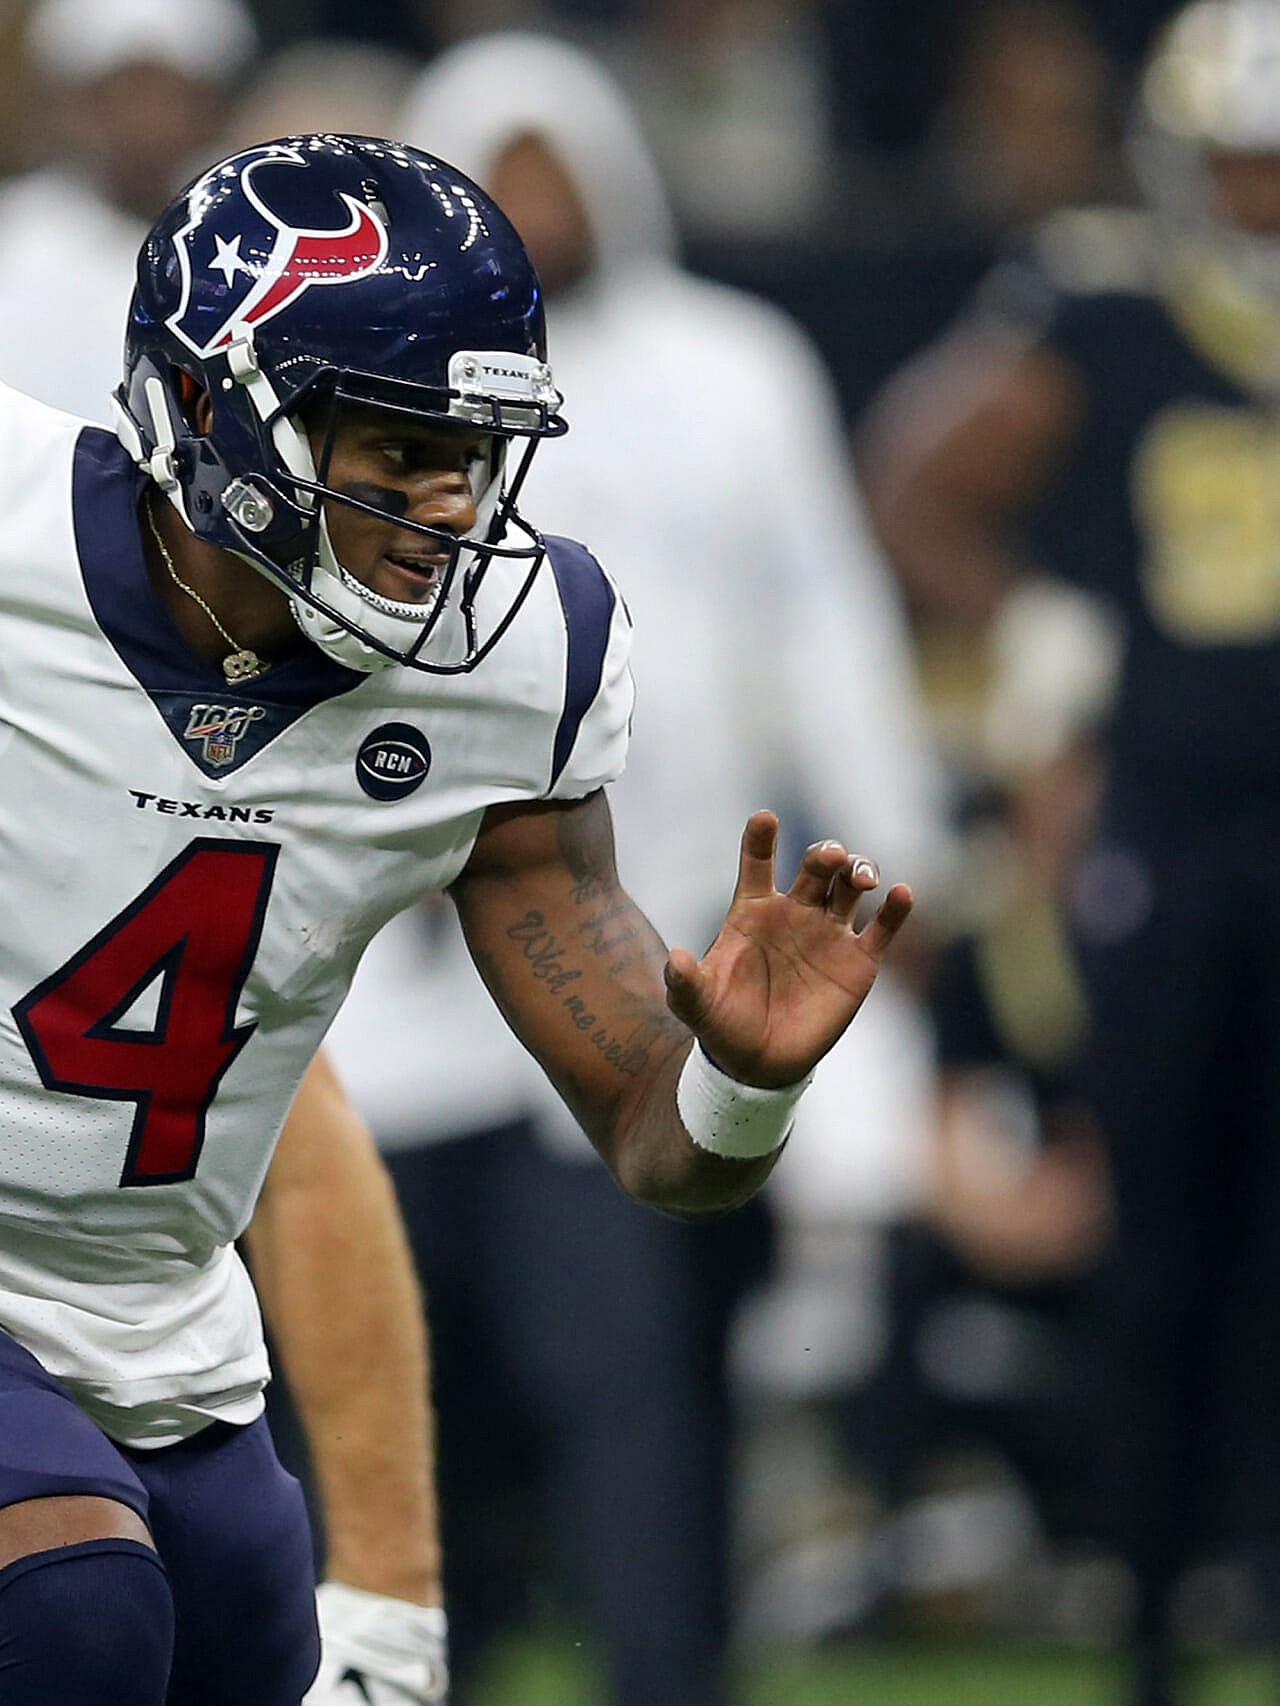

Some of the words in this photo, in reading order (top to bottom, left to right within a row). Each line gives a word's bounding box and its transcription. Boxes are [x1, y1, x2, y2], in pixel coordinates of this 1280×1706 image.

[481, 366, 530, 380] TEXANS
[209, 744, 232, 761] NFL
[128, 788, 277, 824] TEXANS
[10, 836, 282, 1188] 4
